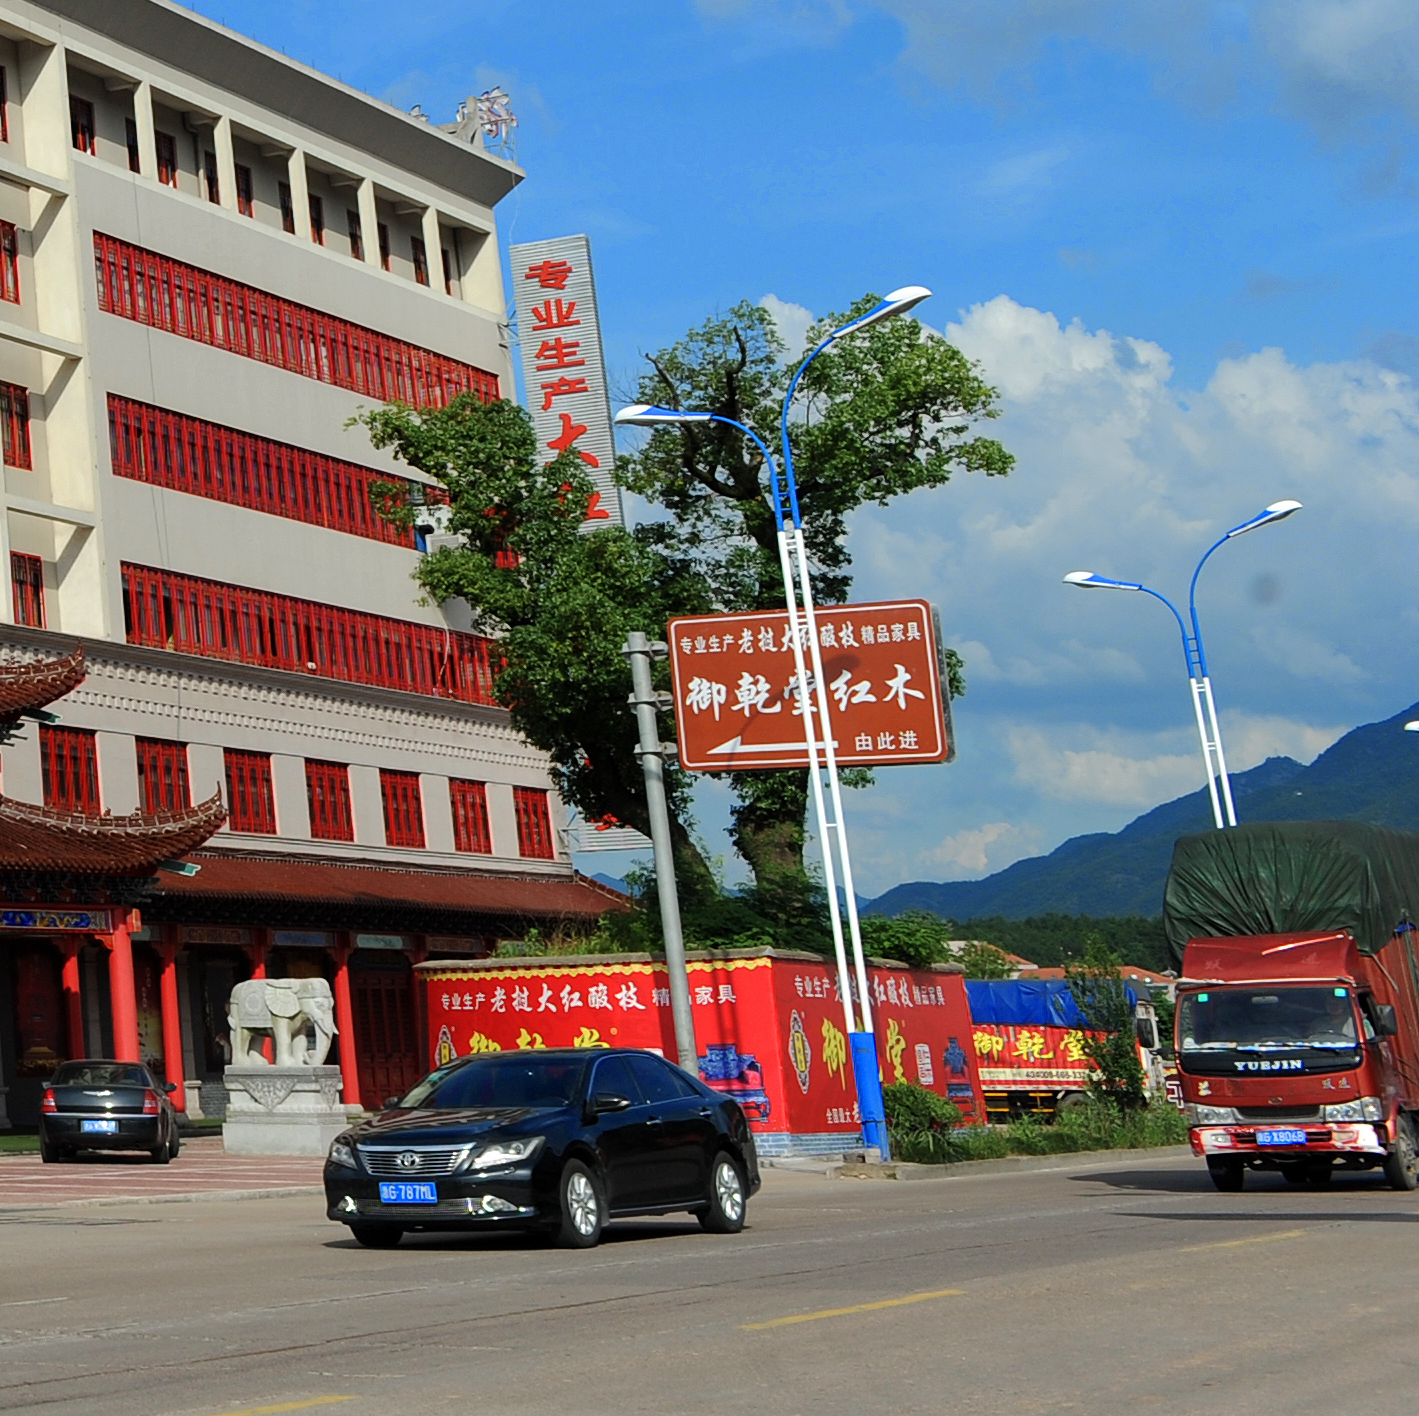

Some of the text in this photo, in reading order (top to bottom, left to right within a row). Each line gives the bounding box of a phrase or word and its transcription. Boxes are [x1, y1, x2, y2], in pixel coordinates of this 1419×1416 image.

[525, 260, 610, 520] 专业生产大
[855, 731, 920, 752] 由此进
[440, 981, 737, 1014] 专业生产老挝大红酸枝精家具
[822, 1017, 907, 1091] 御堂
[1234, 1059, 1303, 1071] YUEJIN
